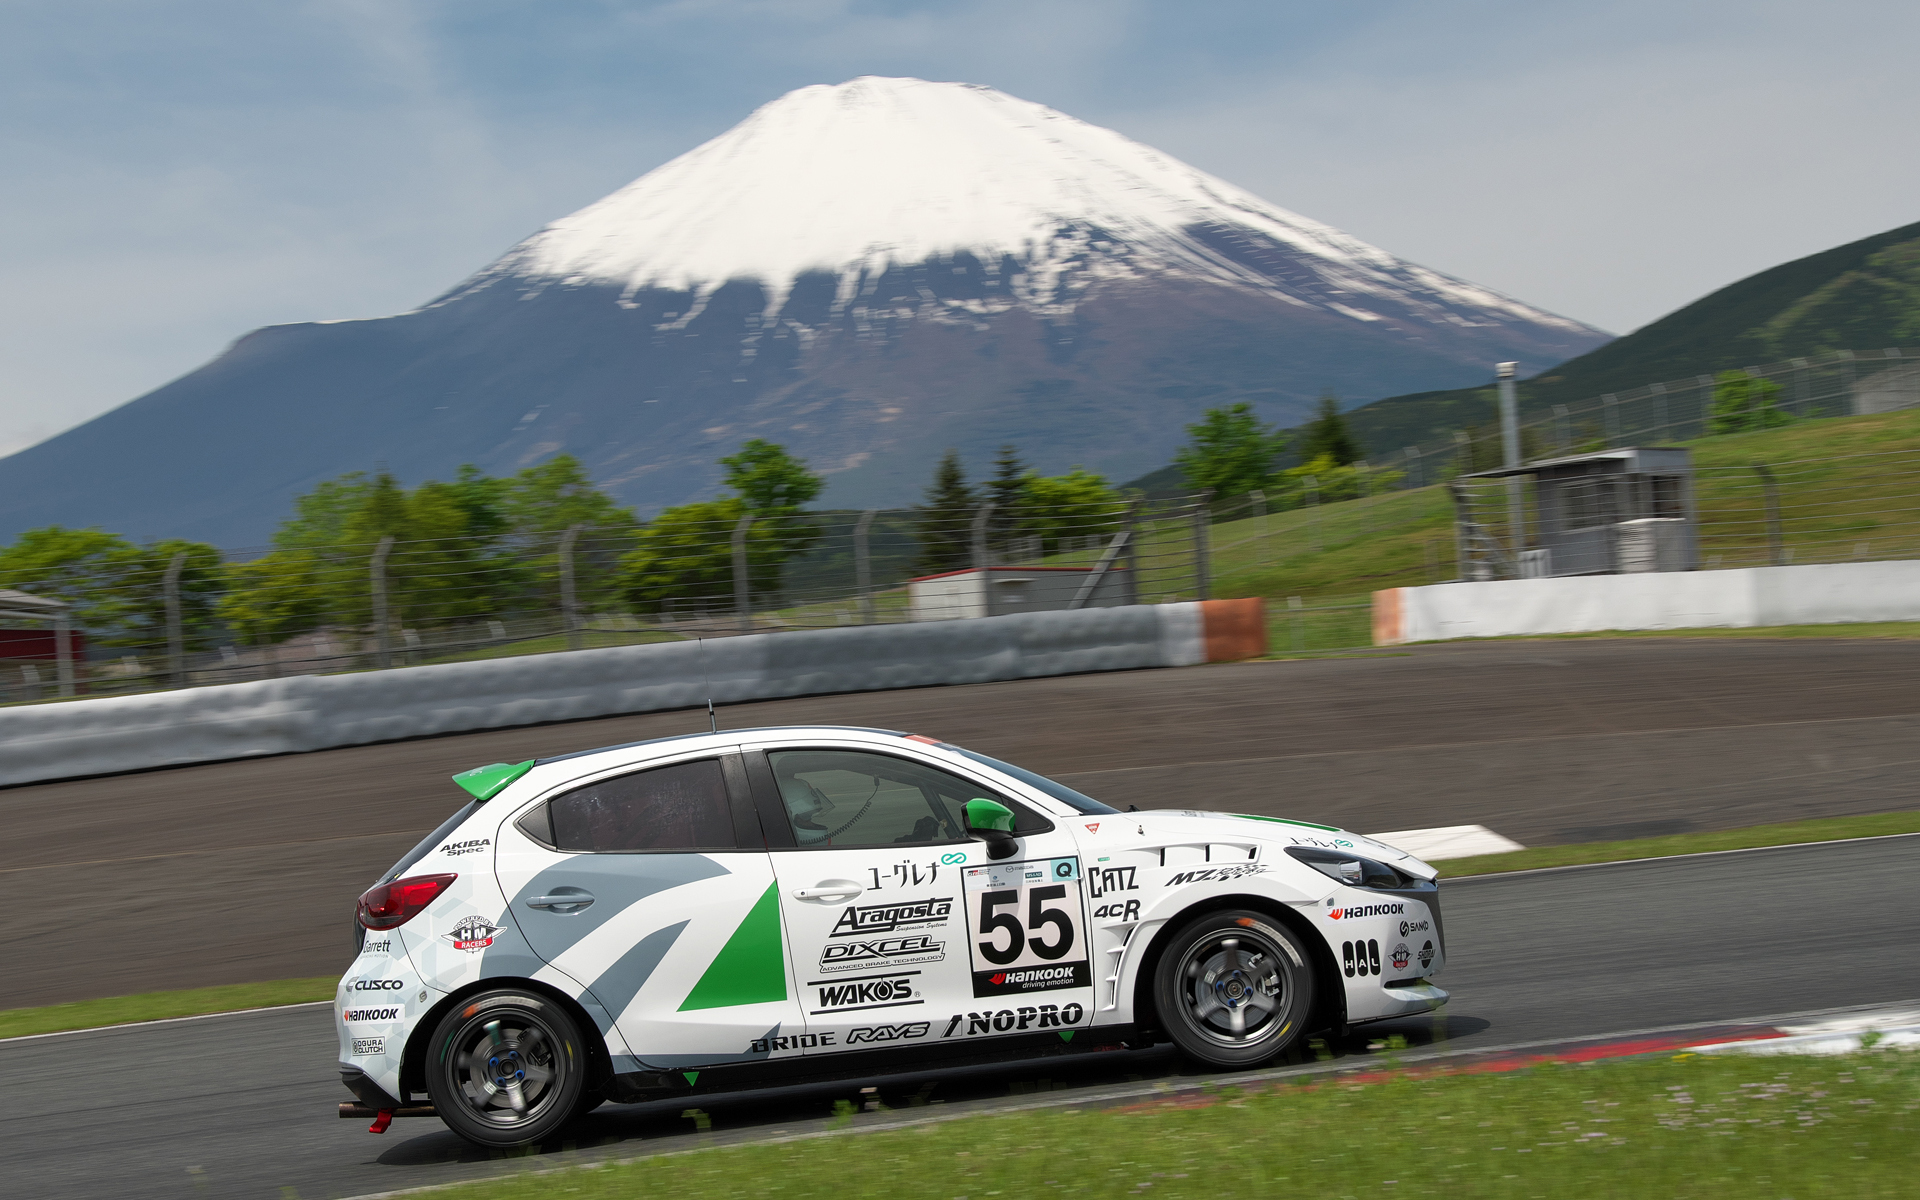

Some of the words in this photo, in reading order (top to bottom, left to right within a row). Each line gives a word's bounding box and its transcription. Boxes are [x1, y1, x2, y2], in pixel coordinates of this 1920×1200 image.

[439, 838, 491, 853] AKIBA
[446, 847, 485, 857] Spec
[867, 859, 940, 891] ユーグレナ
[1055, 862, 1073, 878] Q
[1088, 866, 1140, 899] CATZ
[830, 897, 953, 937] Aragosta
[1093, 899, 1141, 922] 4CR
[978, 884, 1075, 965] 55
[461, 939, 487, 949] RACERS
[823, 936, 941, 960] DIXCEL
[822, 963, 864, 973] ADVANCED
[865, 960, 891, 968] BRAKE
[893, 954, 943, 965] TECHNOLOGY
[1345, 957, 1379, 970] HAL
[355, 979, 404, 991] CUSCO
[1022, 980, 1045, 989] driving
[1046, 977, 1074, 986] emotion
[966, 1002, 1084, 1036] NOPRO
[750, 1030, 837, 1053] BRIDE
[846, 1020, 931, 1044] RAYS
